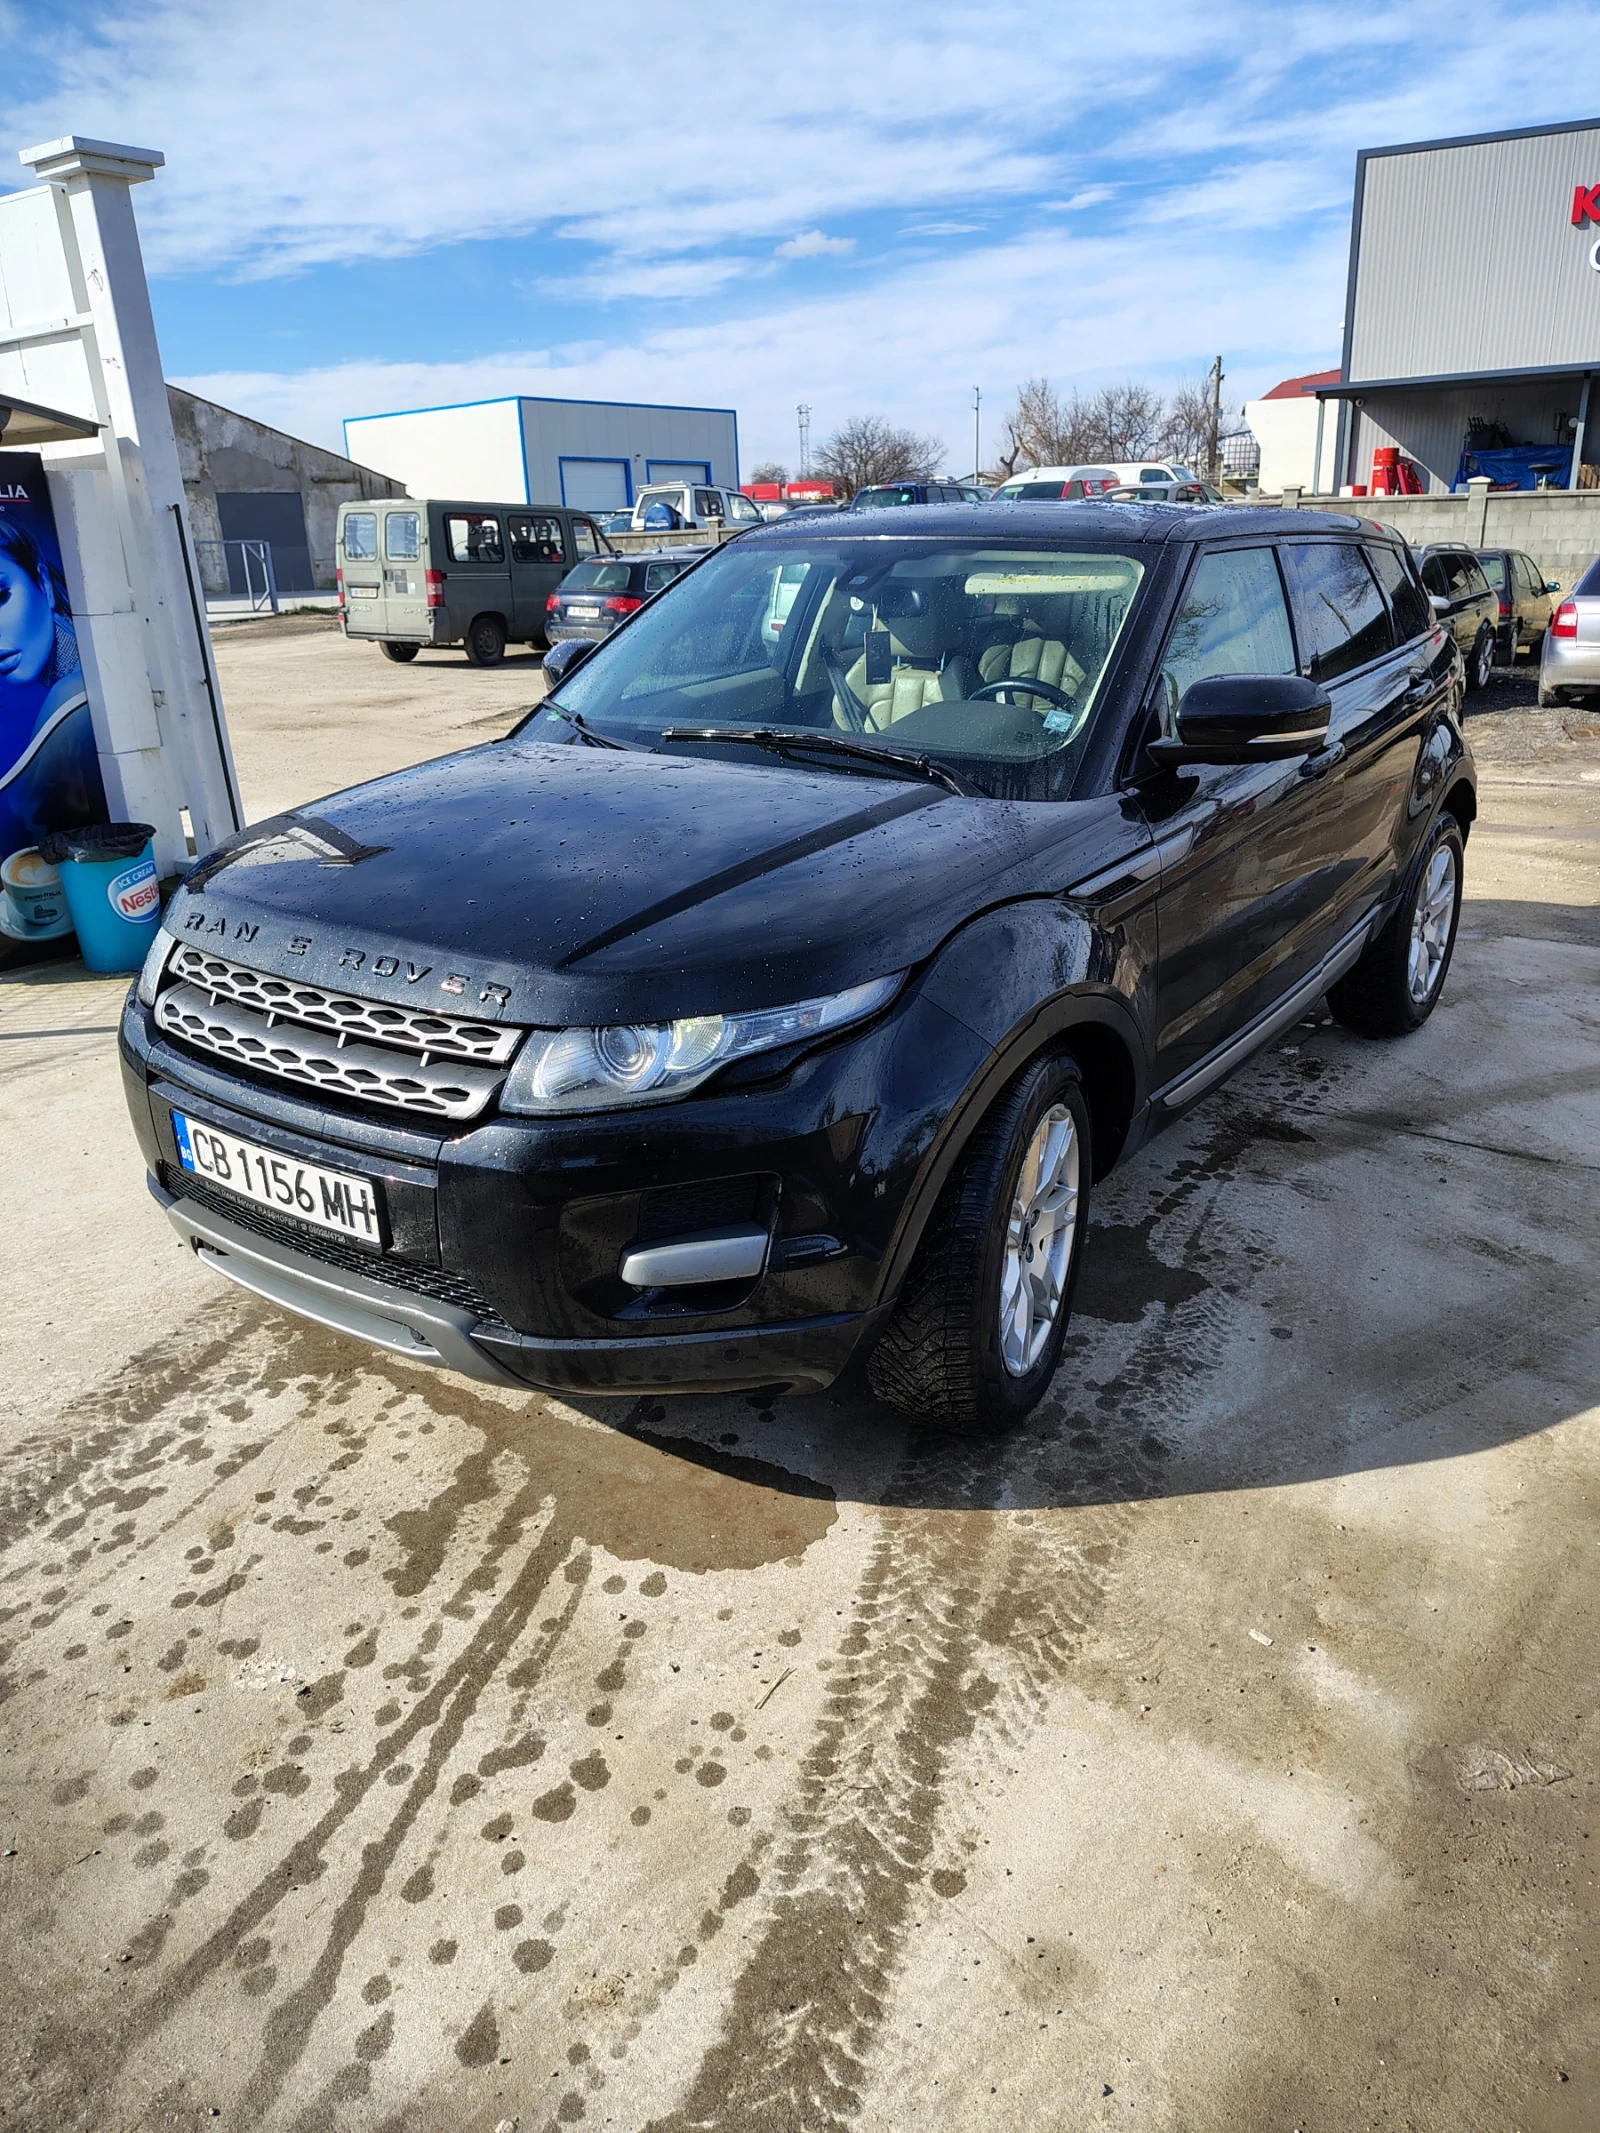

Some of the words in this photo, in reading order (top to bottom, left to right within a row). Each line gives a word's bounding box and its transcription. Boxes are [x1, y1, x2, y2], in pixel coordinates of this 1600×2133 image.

[118, 876, 132, 889] ICE
[338, 947, 512, 1007] ROVER
[180, 1146, 193, 1162] BG
[236, 1147, 316, 1214] 1156
